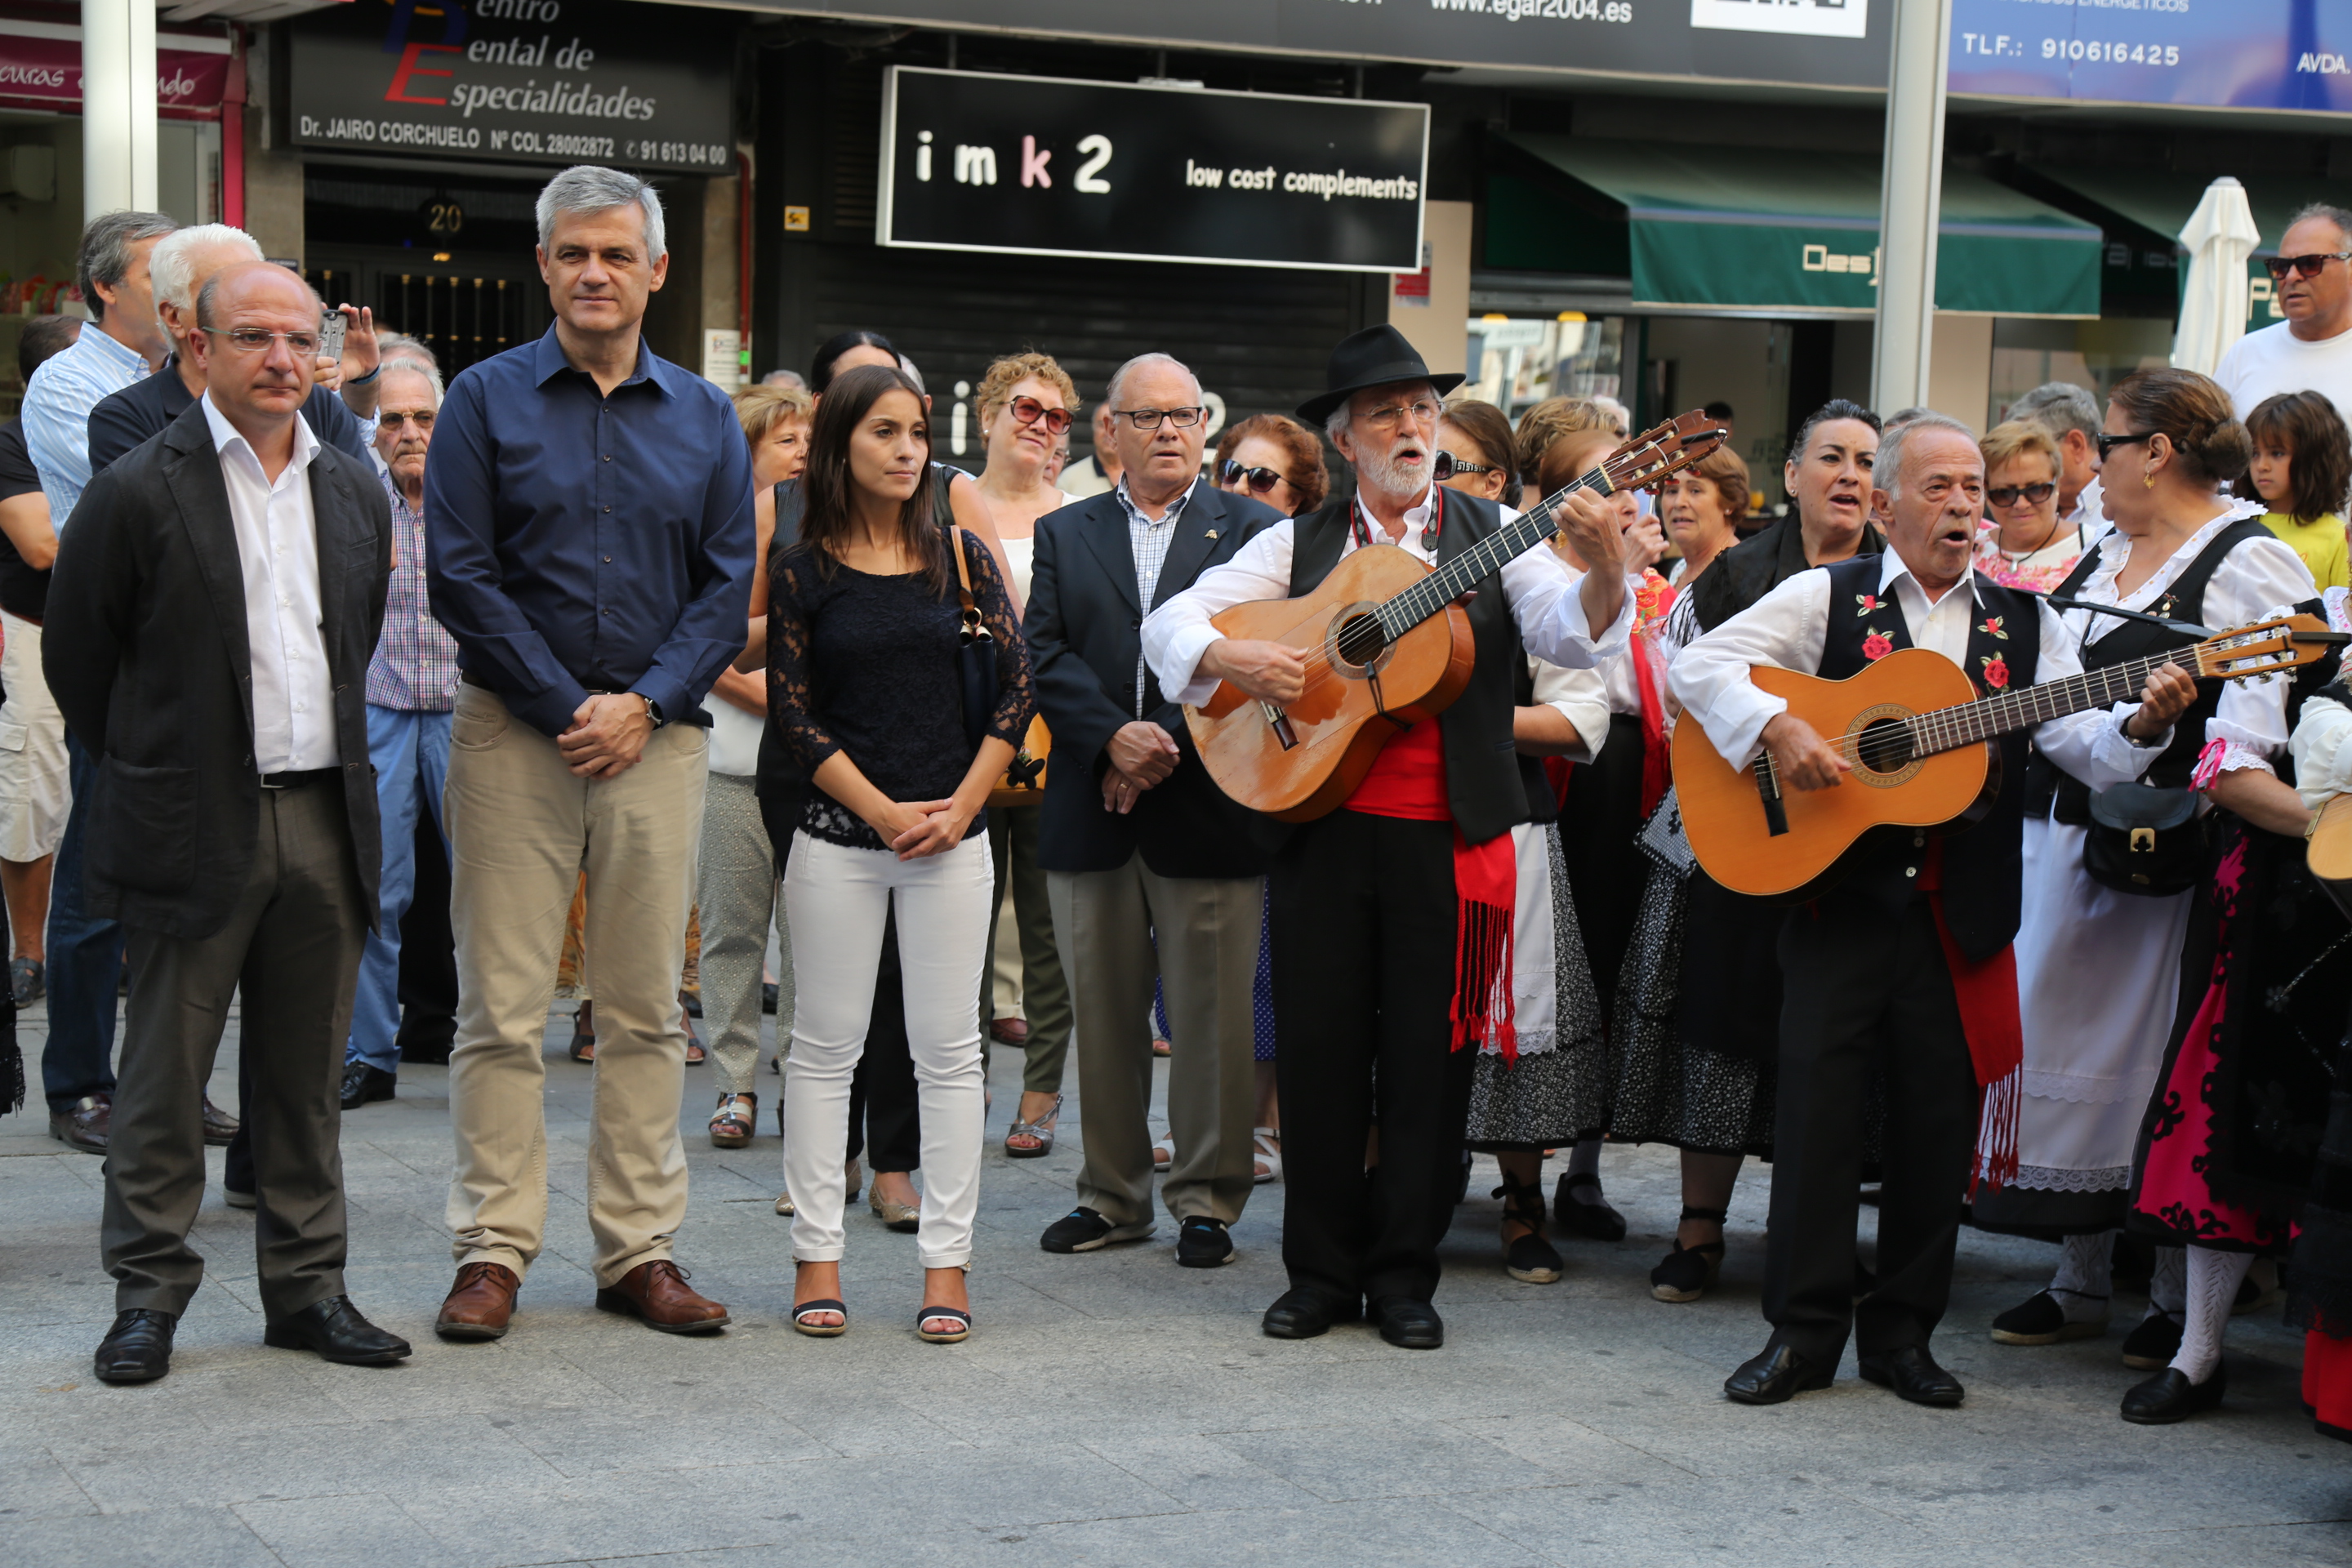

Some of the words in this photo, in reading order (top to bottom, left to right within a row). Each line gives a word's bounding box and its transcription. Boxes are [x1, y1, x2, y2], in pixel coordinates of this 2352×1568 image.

[555, 38, 595, 71] de
[2041, 38, 2180, 66] 910616425
[301, 115, 323, 137] Dr.
[327, 118, 376, 141] JAIRO
[379, 121, 480, 149] CORCHUELO
[511, 131, 544, 154] COL
[546, 133, 614, 158] 28002872
[640, 140, 658, 161] 91
[662, 142, 687, 163] 613
[689, 144, 707, 163] 04
[709, 145, 727, 165] 00
[1186, 158, 1224, 189] low
[1228, 165, 1277, 191] cost
[1283, 167, 1419, 202] complements
[430, 203, 462, 233] 20
